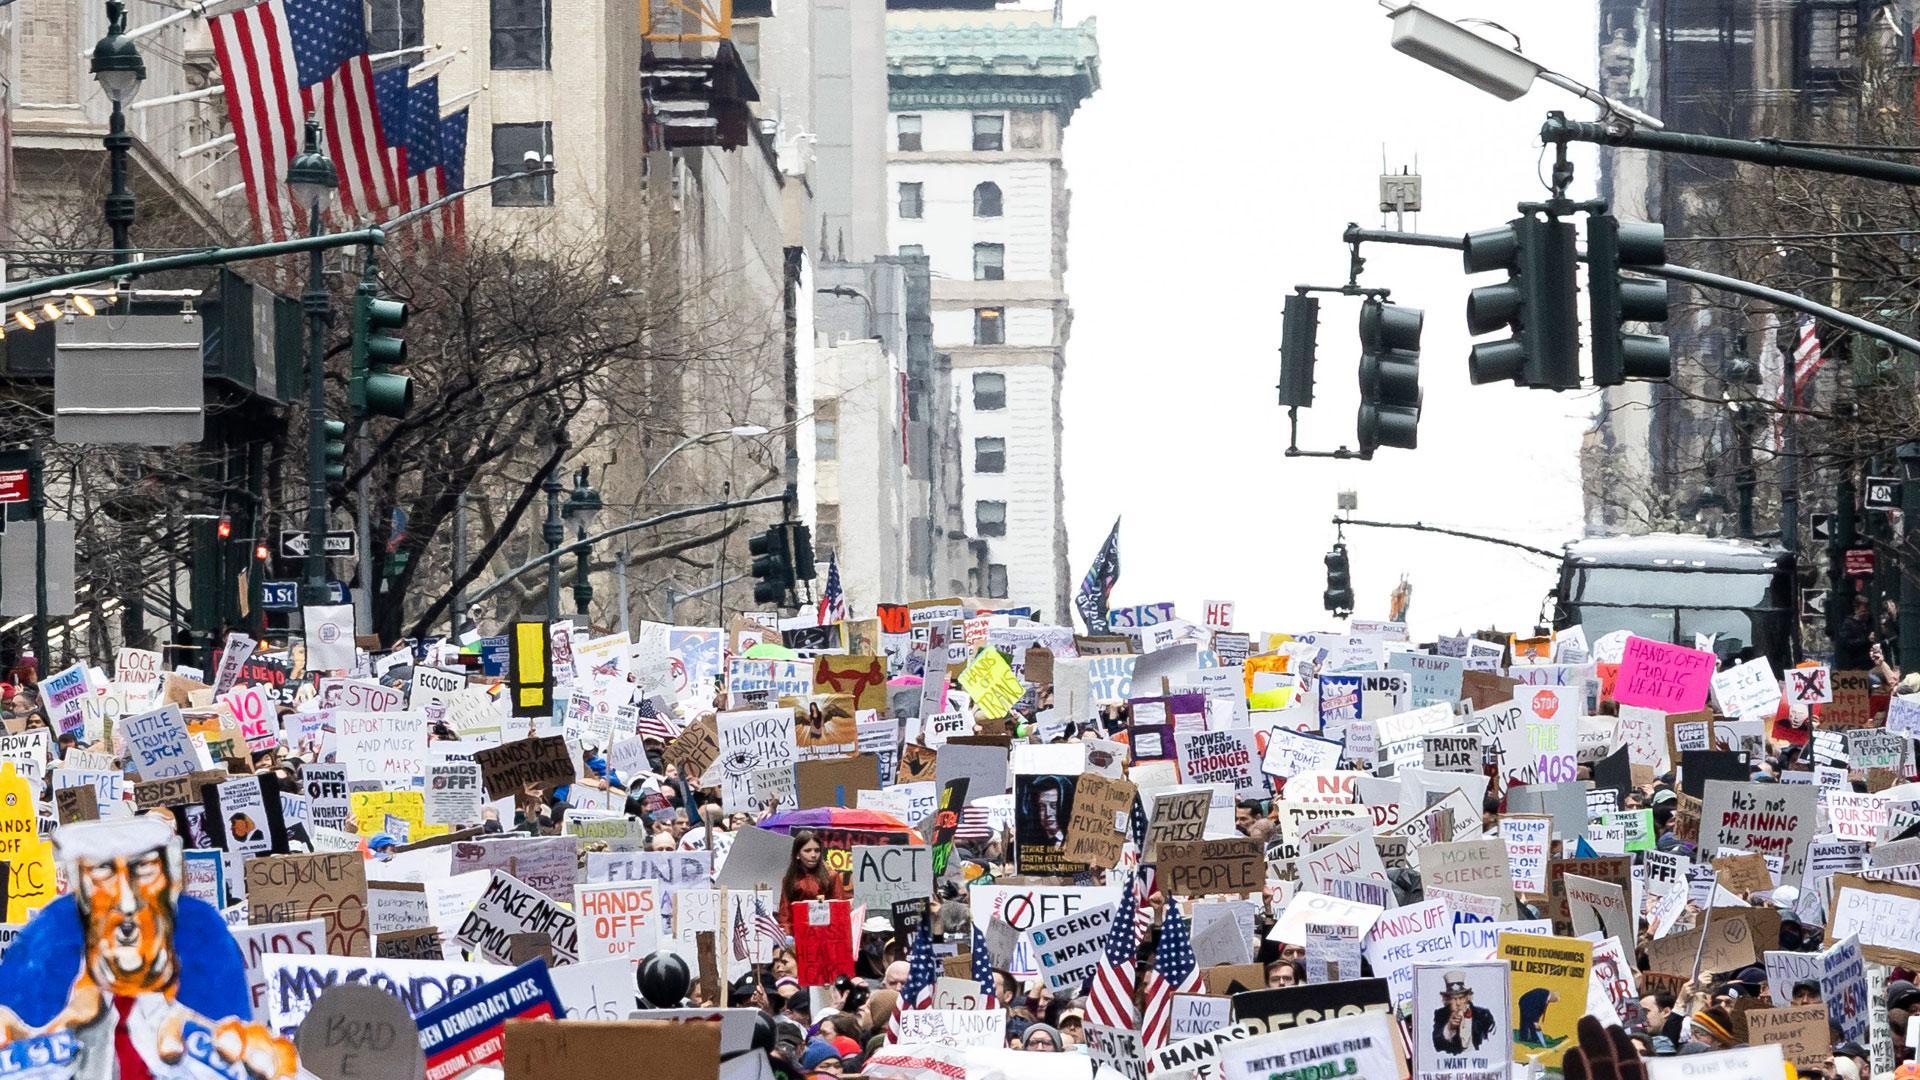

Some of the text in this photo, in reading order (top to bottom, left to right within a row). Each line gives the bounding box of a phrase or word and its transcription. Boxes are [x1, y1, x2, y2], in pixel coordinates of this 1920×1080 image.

[328, 539, 346, 548] WAY
[277, 588, 293, 603] St
[878, 606, 909, 633] NO
[912, 608, 959, 621] PROTECT
[1207, 603, 1233, 627] HE
[120, 652, 156, 670] LOCK
[1629, 641, 1672, 663] HANDS
[785, 663, 796, 678] A
[1411, 658, 1450, 671] TRUMP
[50, 671, 80, 690] TRANS
[420, 673, 459, 691] ECOCIDE
[1519, 669, 1548, 686] NO
[1637, 664, 1691, 686] PUBLIC
[1832, 672, 1868, 689] Seen
[55, 685, 84, 703] RIGHTS
[1629, 679, 1684, 699] HEALTH
[345, 685, 398, 712] STOP
[1533, 697, 1558, 709] STOP
[64, 701, 81, 716] ARE
[86, 697, 119, 719] NO
[1326, 709, 1354, 720] MAIL
[127, 712, 173, 737] LITTLE
[934, 713, 963, 722] HANDS
[343, 719, 386, 735] DEPORT
[389, 719, 422, 733] TRUMP
[724, 717, 790, 747] HISTORY
[935, 721, 964, 733] OFF!
[32, 736, 41, 747] A
[357, 739, 415, 752] AND MUSK
[664, 723, 706, 764] HANDS
[1192, 732, 1225, 747] POWER
[1426, 737, 1478, 752] TRAITOR
[1526, 724, 1560, 751] THE
[141, 742, 184, 766] BITCH
[486, 735, 565, 769] HANDS OFF
[757, 741, 790, 760] HAS
[1188, 740, 1242, 760] THE PEOPLE
[1282, 748, 1321, 767] TRUMP
[359, 758, 421, 775] TO MARS
[1188, 750, 1250, 775] STRONGER
[1434, 753, 1471, 767] LIAR
[306, 770, 345, 781] HANDS
[432, 766, 477, 775] HANDS
[486, 758, 575, 790] IMMIGRANTS
[1203, 768, 1239, 783] PEOPLE
[135, 779, 190, 802] RESIST
[308, 781, 347, 800] OFF!
[432, 775, 477, 790] OFF!
[1317, 774, 1357, 794] NO
[1078, 779, 1130, 807] STOP Trump
[1732, 790, 1785, 812] He's not
[1832, 796, 1870, 808] HANDS
[312, 806, 348, 818] WORKER
[1100, 803, 1113, 820] his
[1156, 799, 1207, 822] FUCK
[1835, 808, 1860, 822] OUR
[1072, 815, 1113, 836] FLYING
[1503, 822, 1545, 832] TRUMP
[1722, 811, 1798, 832] DRAINING
[1151, 821, 1203, 843] THIS!
[1512, 833, 1534, 842] IS A
[1718, 830, 1739, 845] the
[1073, 837, 1119, 861] MONKEYS
[1161, 844, 1191, 862] STOP
[1442, 848, 1488, 863] MORE
[1813, 845, 1864, 856] HANDS OFF
[252, 855, 354, 886] SCHUMER
[608, 857, 705, 884] FUND
[860, 848, 921, 883] ACT
[1308, 841, 1361, 884] DENY
[1552, 862, 1622, 880] RESIST
[10, 862, 44, 890] YC
[528, 876, 560, 887] STOP
[1172, 861, 1255, 890] PEOPLE
[1433, 866, 1502, 884] SCIENCE
[876, 882, 911, 891] LIKE
[484, 875, 535, 918] MAKE
[581, 890, 653, 916] HANDS
[1569, 889, 1601, 907] HANDS
[1848, 895, 1907, 916] BATTLE
[1004, 891, 1082, 932] OFF
[595, 915, 645, 938] OFF
[1032, 908, 1112, 946] DECENCY
[1306, 923, 1354, 935] HANDS OFF
[1370, 904, 1445, 942] HANDS OFF
[415, 935, 441, 950] ARE
[609, 942, 636, 954] our
[1386, 936, 1453, 961] FREE SPEECH
[1505, 945, 1585, 964] CHEETO ECONOMICS
[1823, 945, 1856, 973] Make
[1526, 961, 1569, 977] DESTROY
[1821, 958, 1863, 994] Tyranny
[442, 978, 544, 1039] DEMOCRACY DIES,
[1189, 1001, 1212, 1017] NO
[986, 1014, 1002, 1032] OF
[1175, 1018, 1220, 1034] KINGS
[1750, 1009, 1825, 1027] MY ANCESTORS
[1763, 1027, 1806, 1043] FOUGHT
[1289, 1043, 1341, 1065] STEALING
[1342, 1037, 1373, 1053] FROM
[1444, 1058, 1488, 1070] WANT YOU
